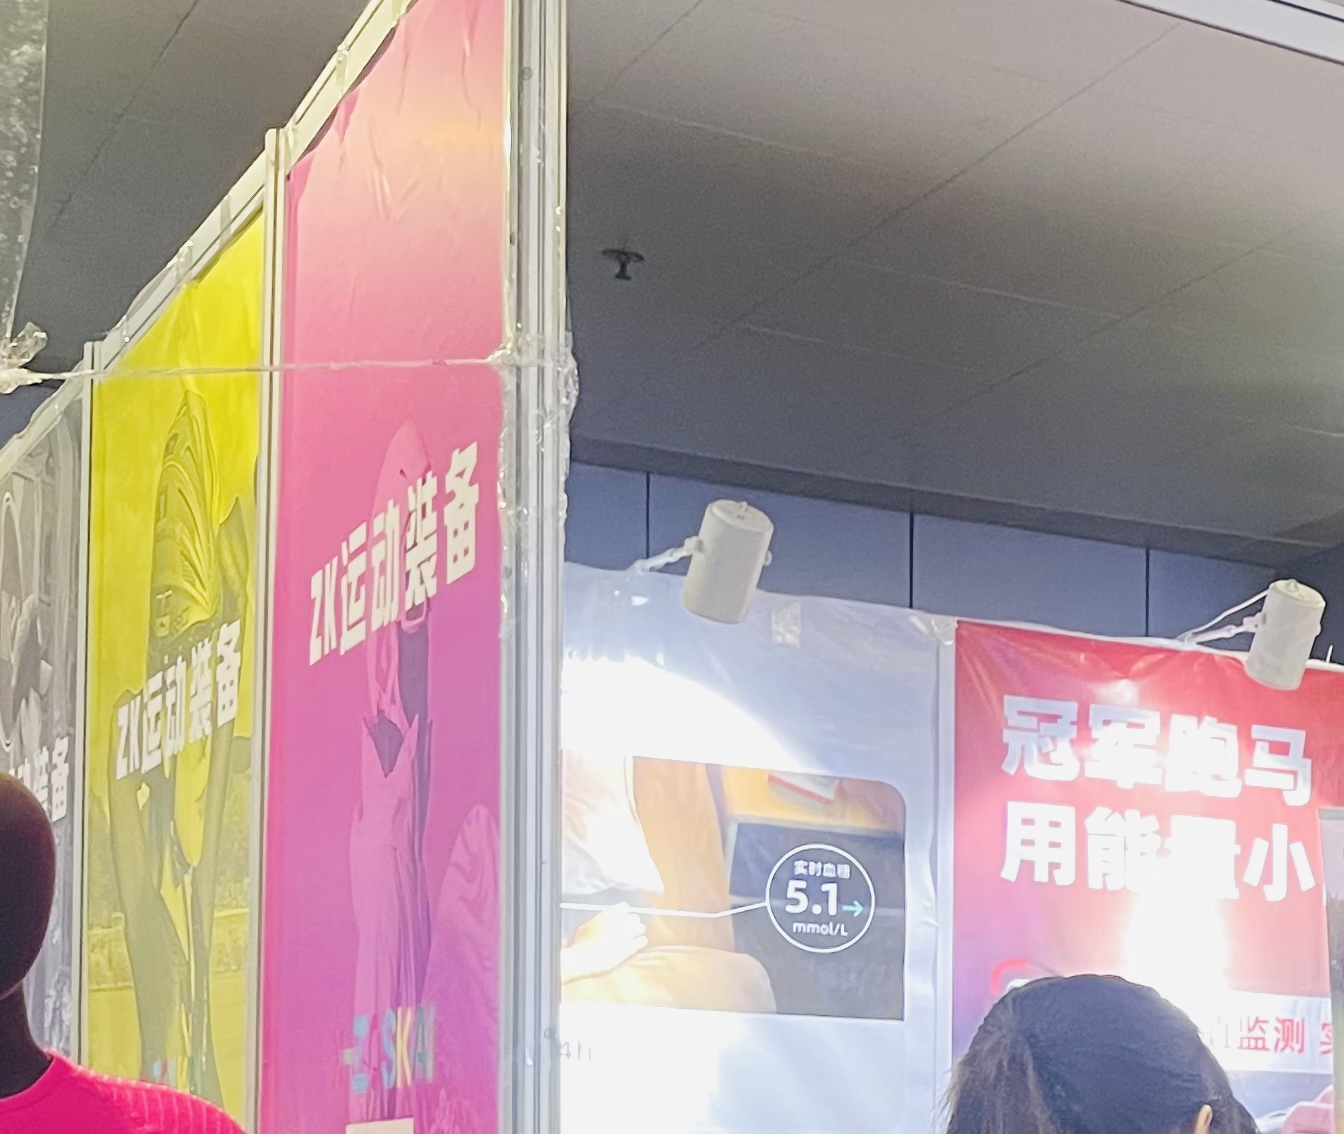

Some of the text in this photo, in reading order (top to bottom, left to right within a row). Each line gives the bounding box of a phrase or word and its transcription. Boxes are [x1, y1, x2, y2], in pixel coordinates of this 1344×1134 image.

[307, 441, 480, 665] ZK运动装备
[115, 620, 241, 780] ZK运动装备
[1000, 694, 1312, 806] 冠军跑马
[785, 880, 838, 916] 5.1
[1000, 801, 1316, 902] 用能量小
[792, 922, 848, 936] mmol/L
